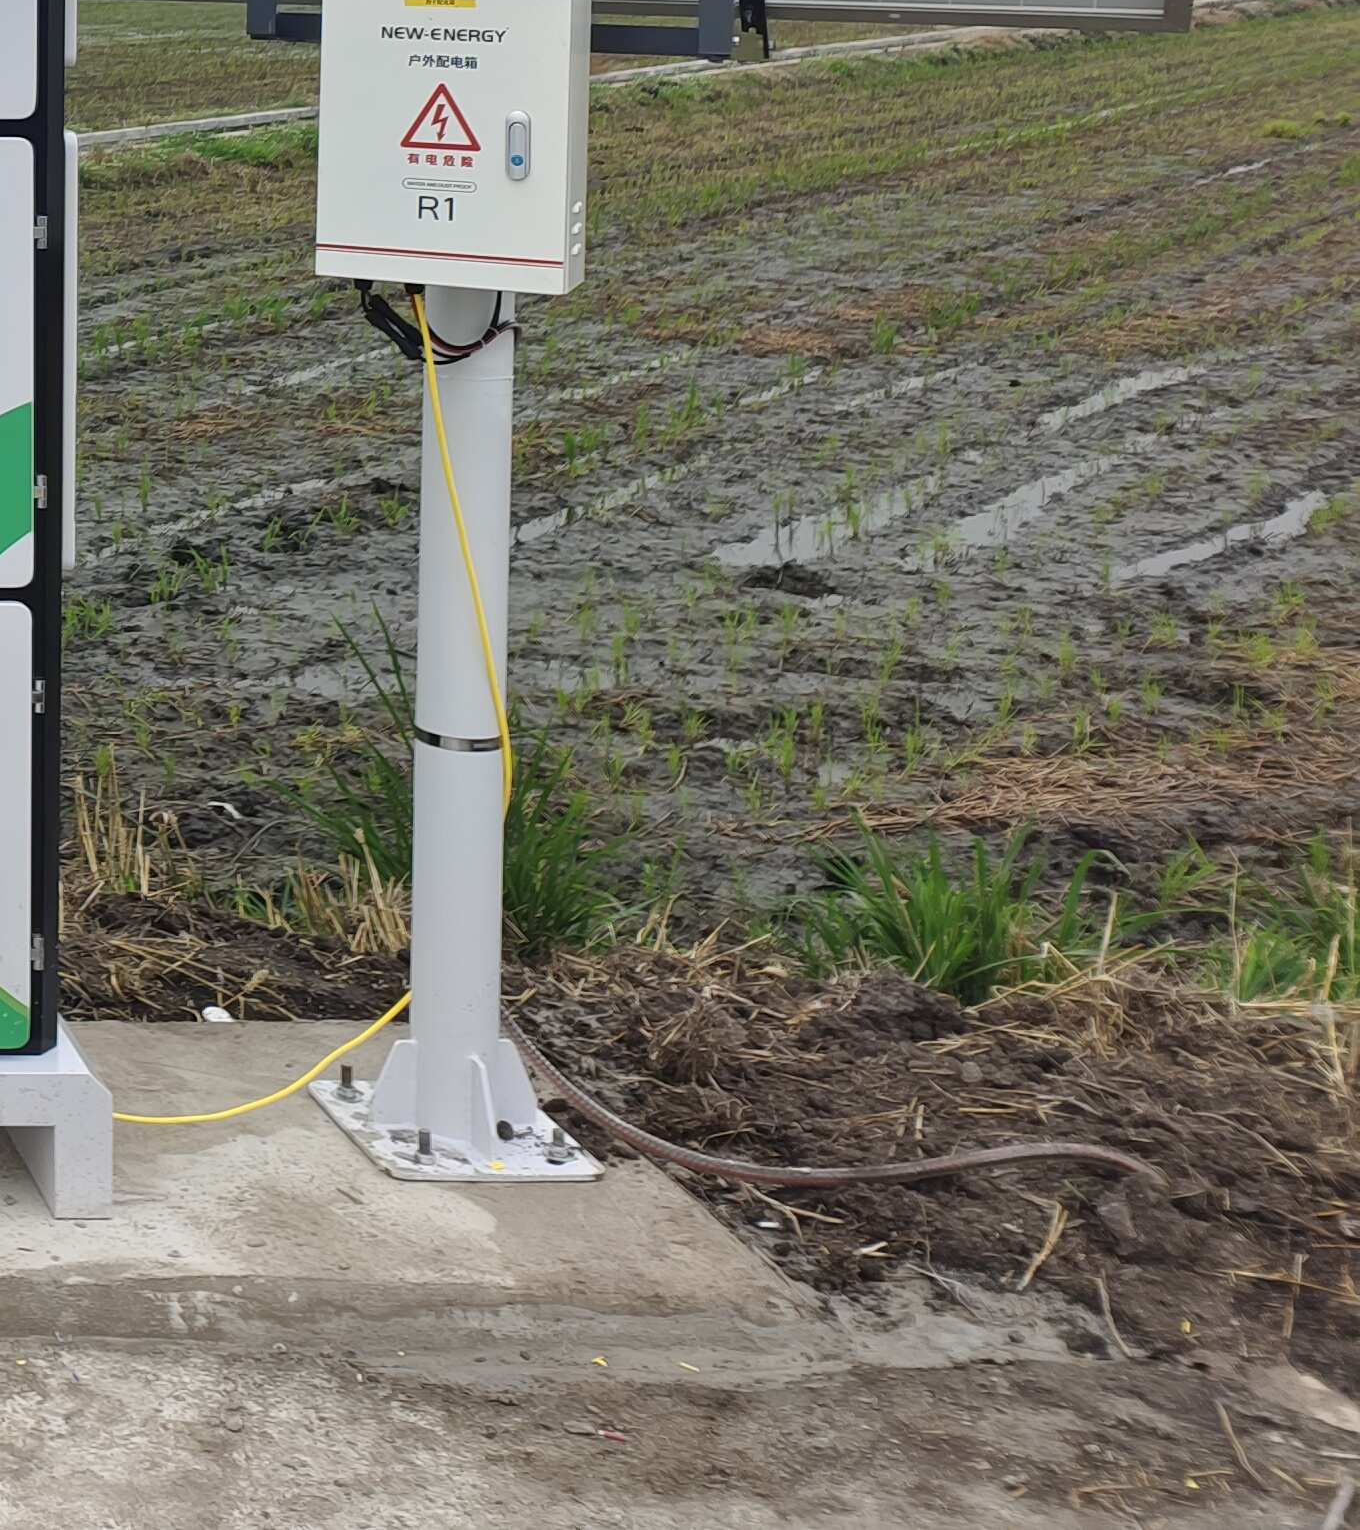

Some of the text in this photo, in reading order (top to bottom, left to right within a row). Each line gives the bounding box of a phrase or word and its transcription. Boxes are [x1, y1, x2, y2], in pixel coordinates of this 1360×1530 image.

[381, 26, 507, 44] NEW-ENERGY
[407, 54, 479, 71] 户外配电箱
[407, 152, 474, 168] 有电危险
[417, 195, 457, 222] R1
